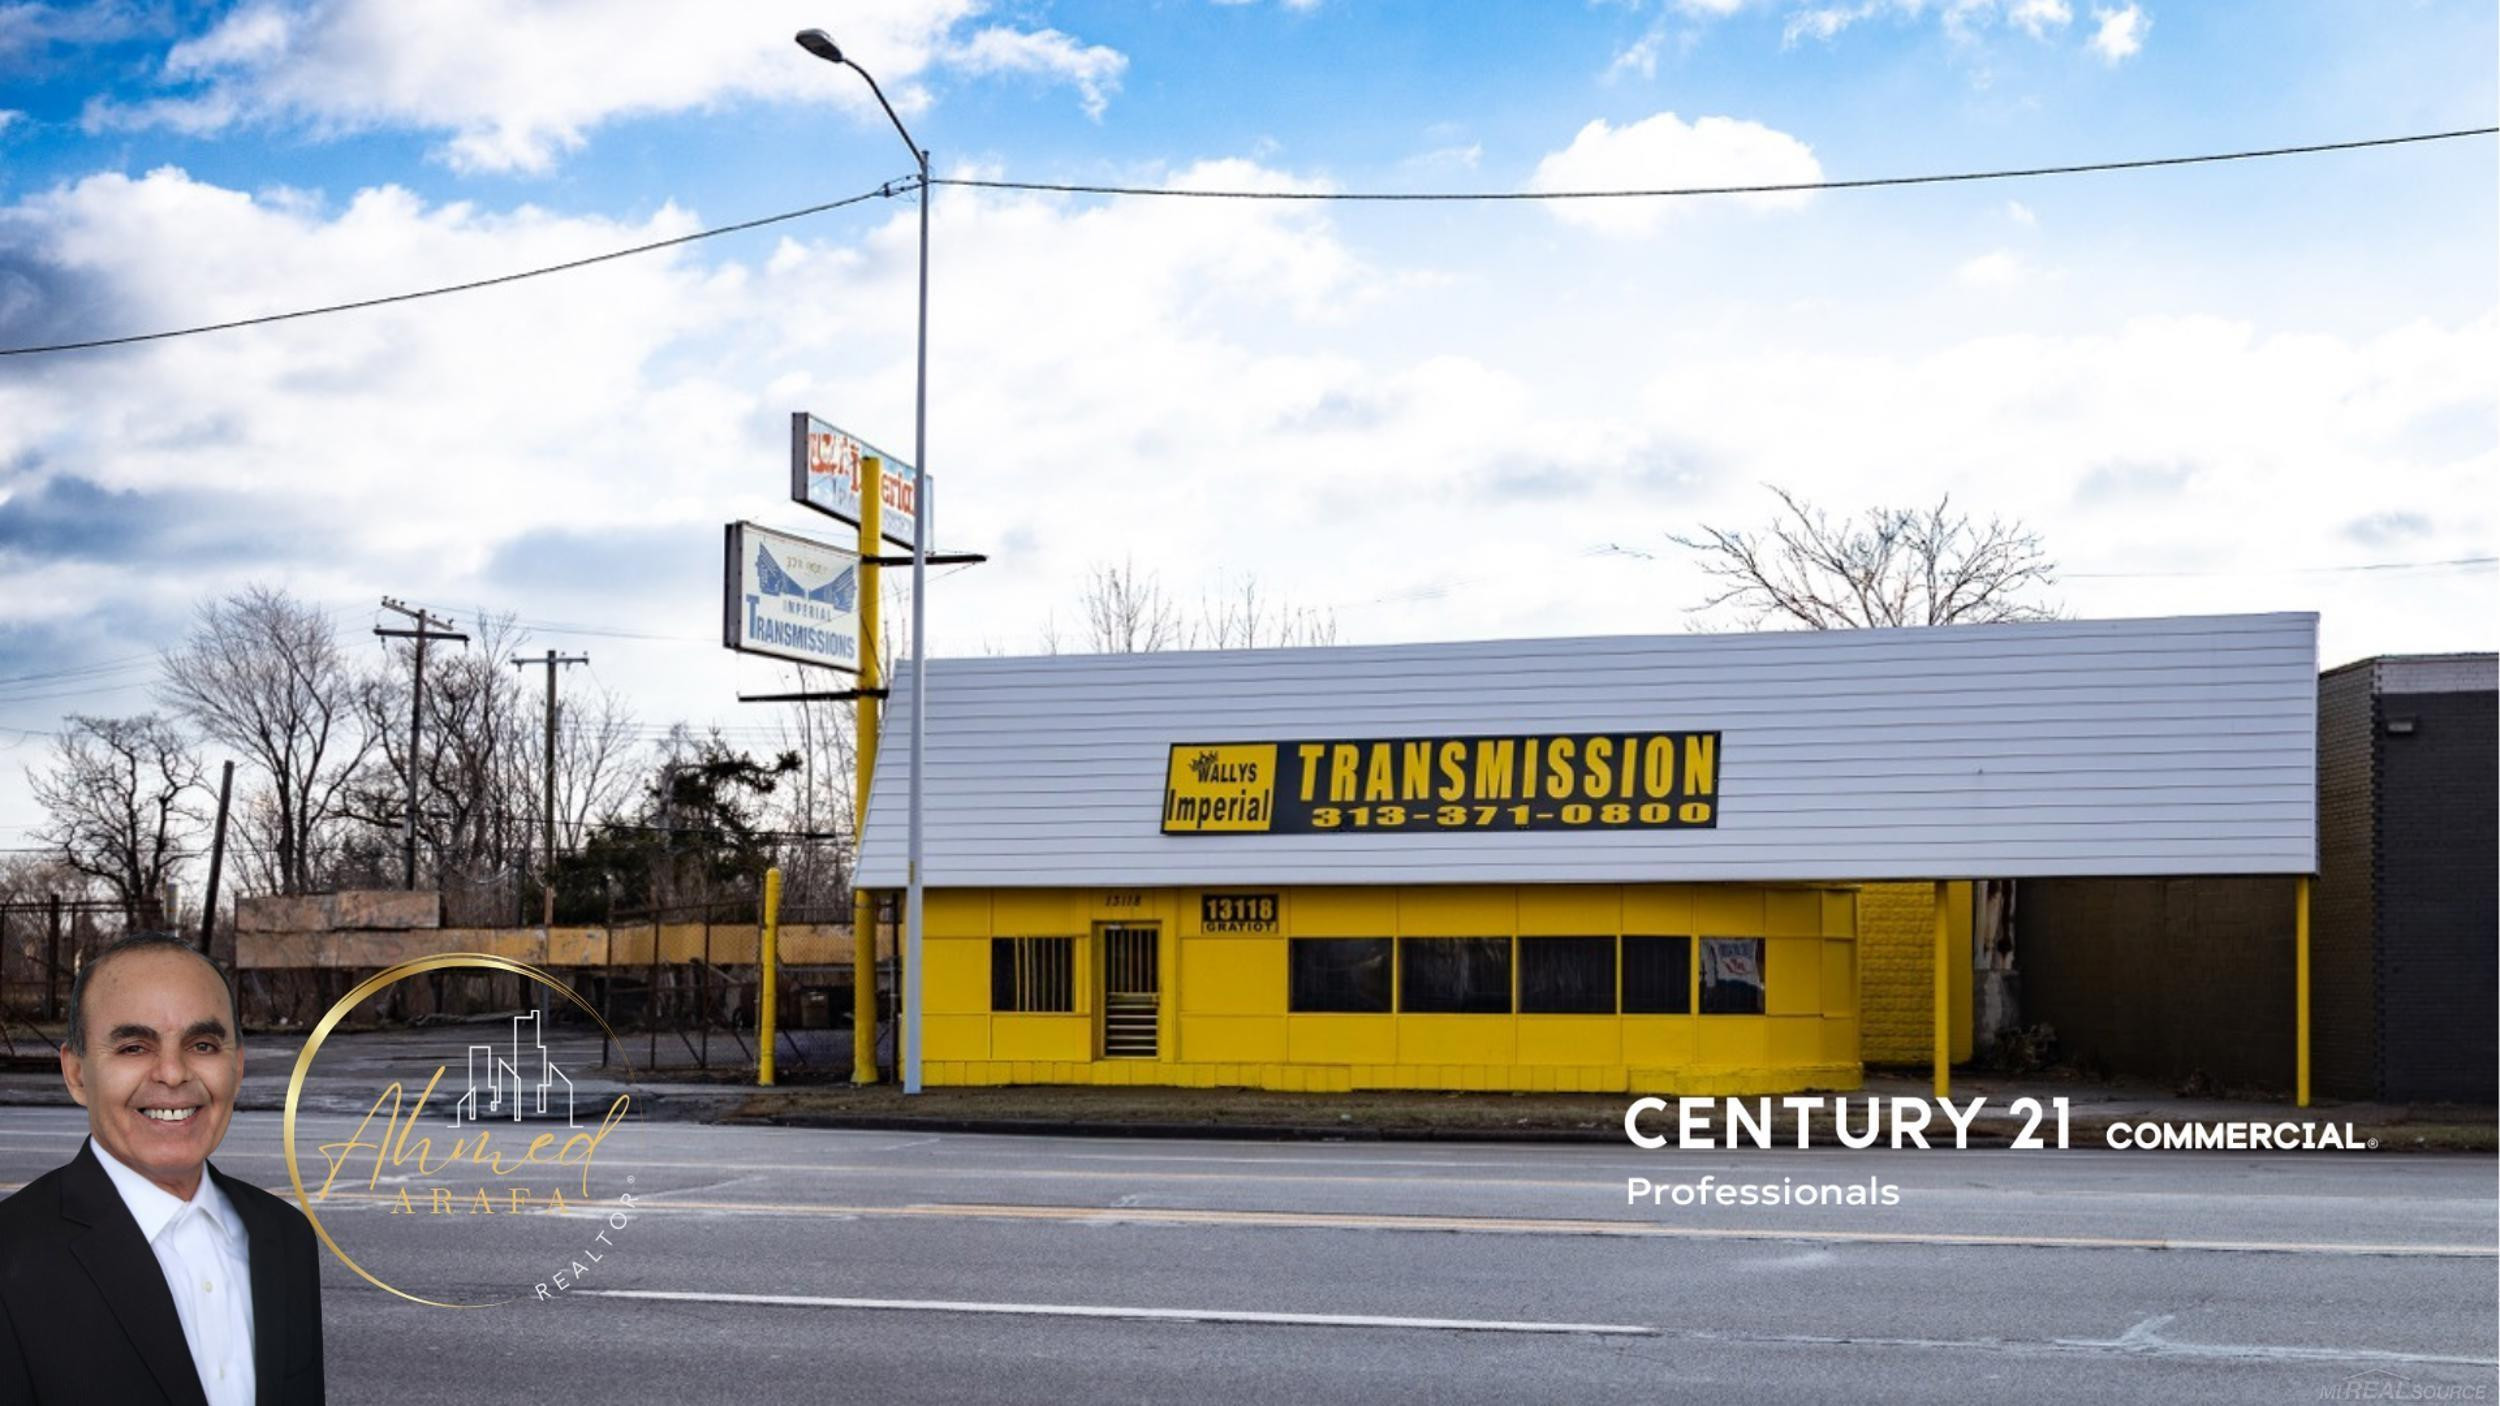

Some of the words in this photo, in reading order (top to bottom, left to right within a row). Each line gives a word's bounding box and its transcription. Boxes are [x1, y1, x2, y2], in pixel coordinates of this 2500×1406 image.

[746, 594, 855, 659] TRANSMISSIONS
[1197, 762, 1258, 782] WALLYS
[1299, 734, 1715, 802] TRANSMISSION
[1167, 789, 1270, 829] Imperial
[1311, 802, 1711, 828] 313-371-0800
[1207, 898, 1273, 920] 13118
[1206, 921, 1273, 932] GRATIOT
